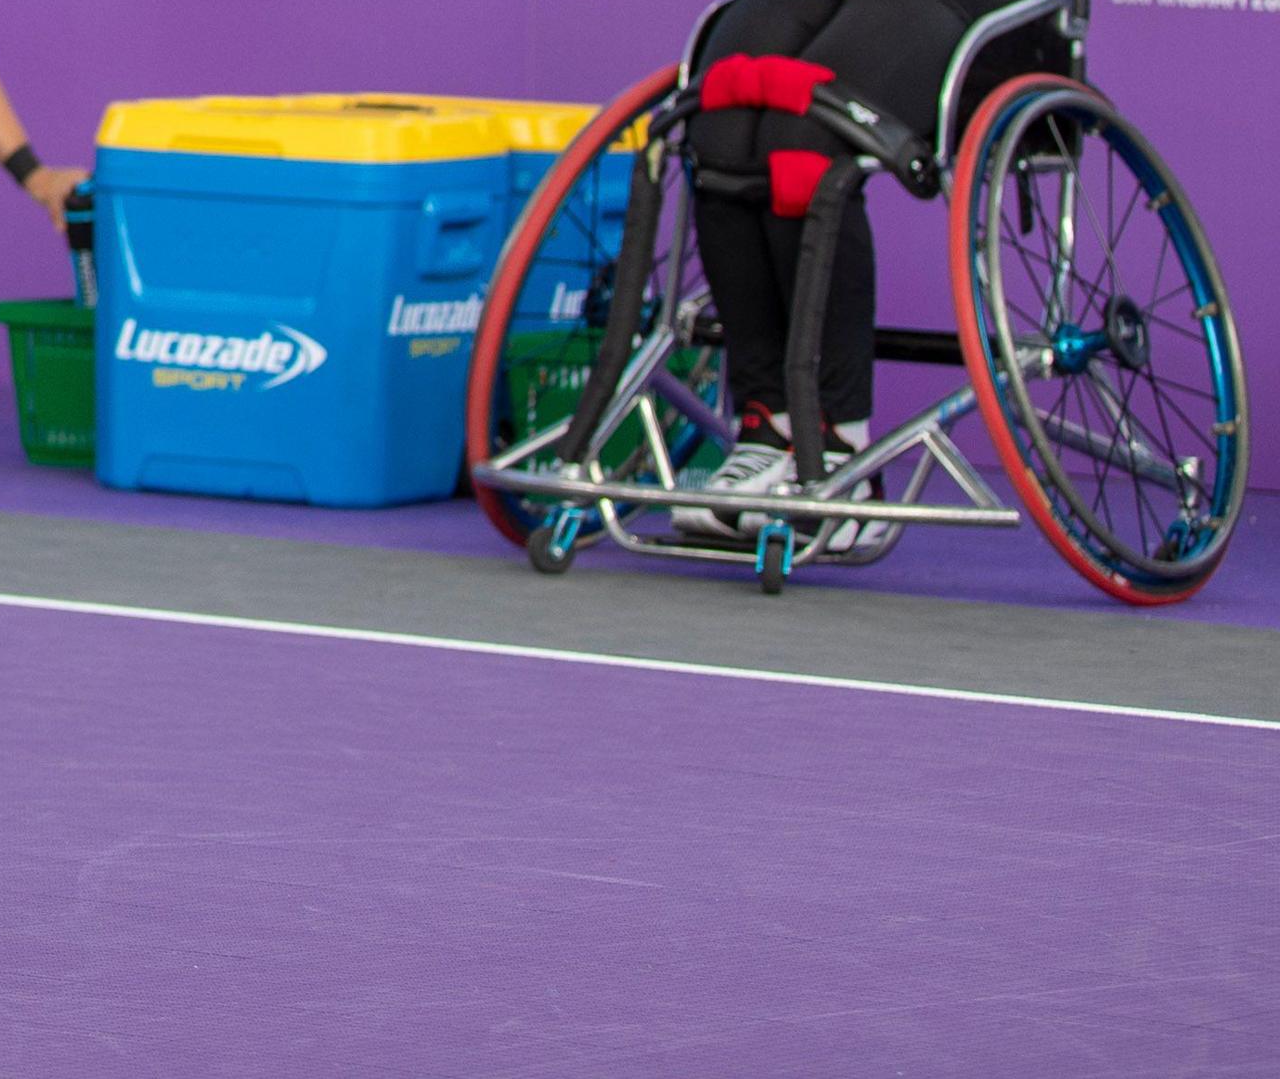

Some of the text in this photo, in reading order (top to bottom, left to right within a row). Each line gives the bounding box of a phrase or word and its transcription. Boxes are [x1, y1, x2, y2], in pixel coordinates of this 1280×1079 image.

[388, 292, 485, 336] Lucozad
[115, 317, 294, 373] Lucozade
[152, 367, 246, 391] SPORT
